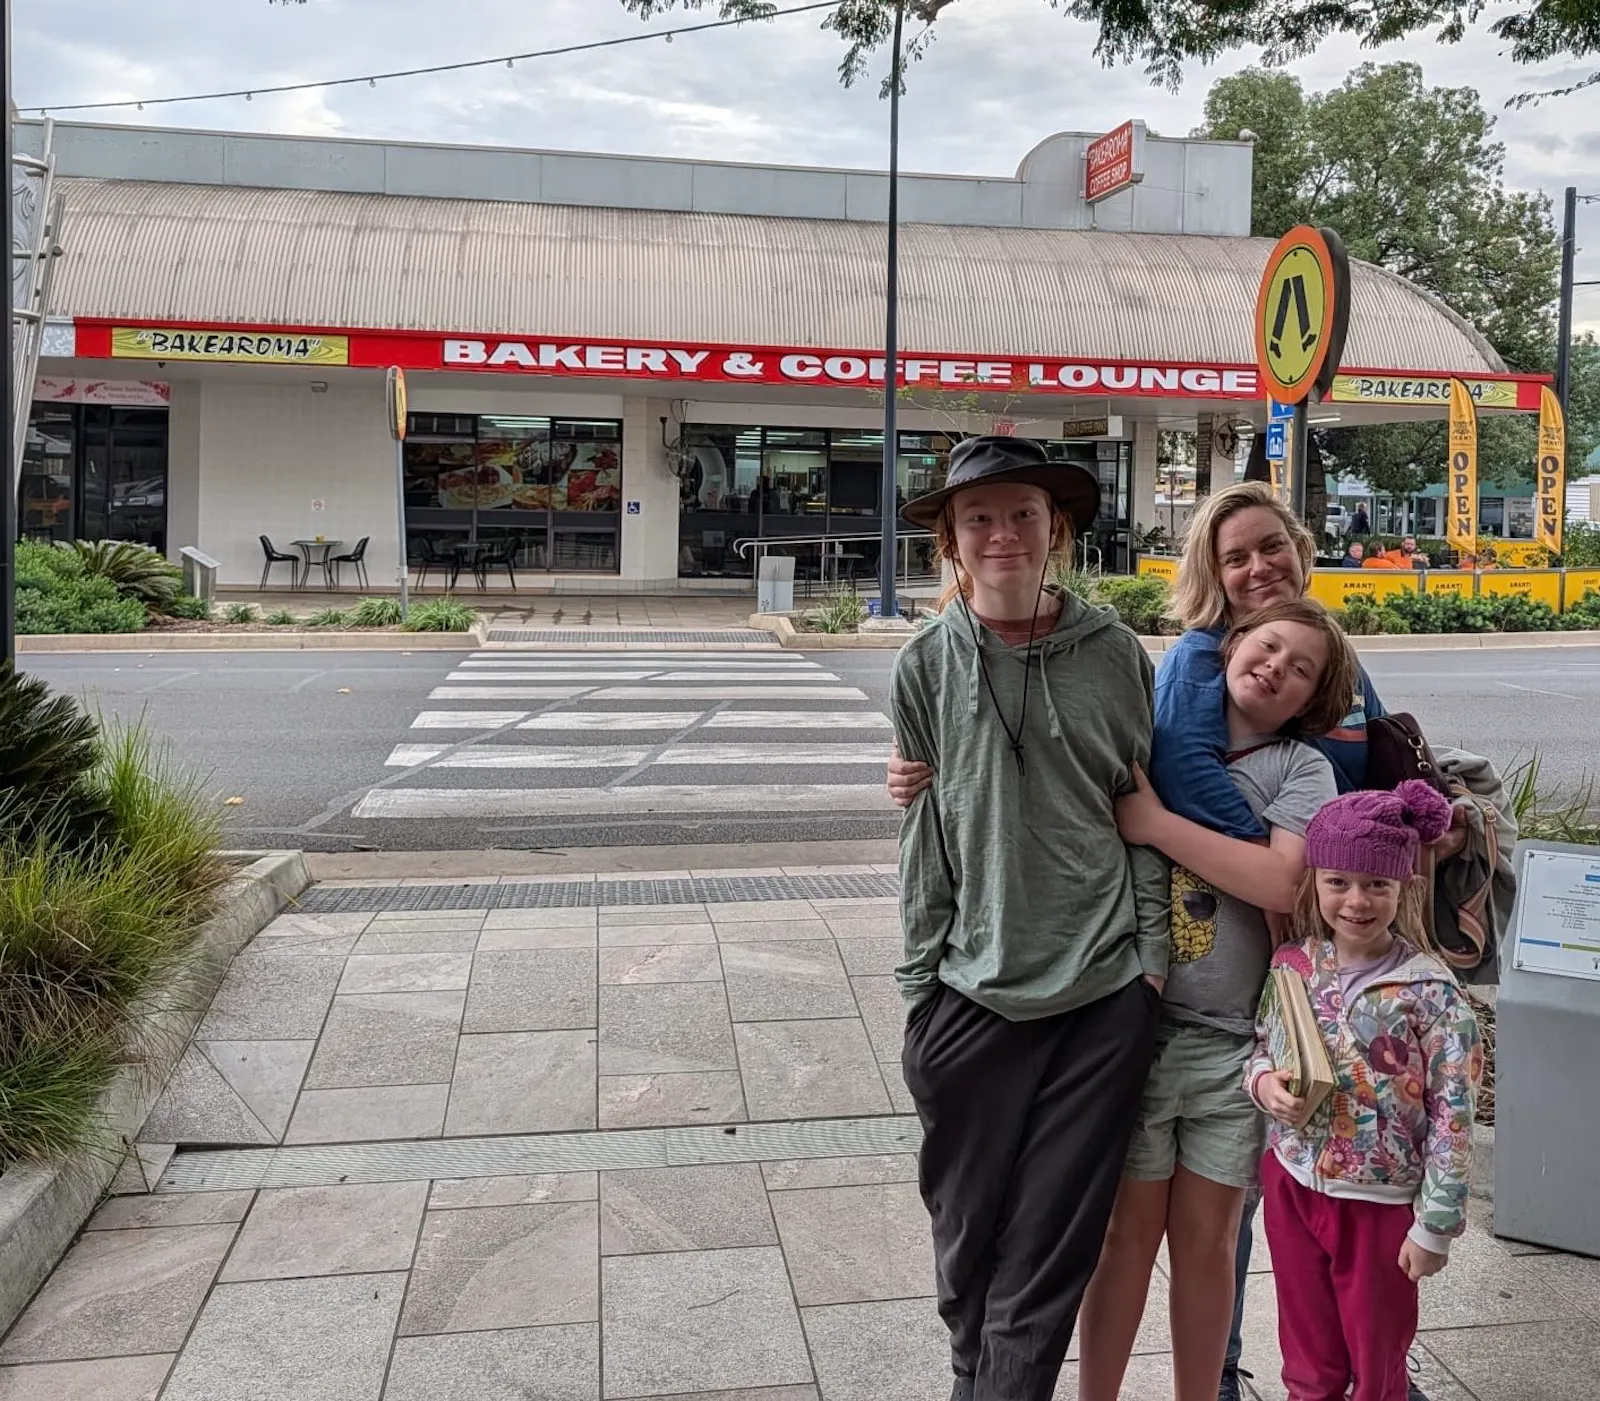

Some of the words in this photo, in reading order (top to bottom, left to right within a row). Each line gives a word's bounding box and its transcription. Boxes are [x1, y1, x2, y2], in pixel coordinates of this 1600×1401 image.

[1090, 170, 1111, 194] COFFEE
[1111, 161, 1127, 184] SHOP
[444, 339, 711, 373] BAKERY
[722, 352, 763, 376] &
[779, 354, 1012, 384] COFFEE
[1029, 363, 1257, 392] LOUNGE
[1350, 379, 1495, 401] "BAKEAROA"
[1453, 452, 1471, 537] OPEN
[1540, 455, 1559, 536] OPEN
[1343, 582, 1376, 590] AMANTI
[1435, 582, 1463, 590] AMANTI
[1510, 581, 1532, 589] AMANTI
